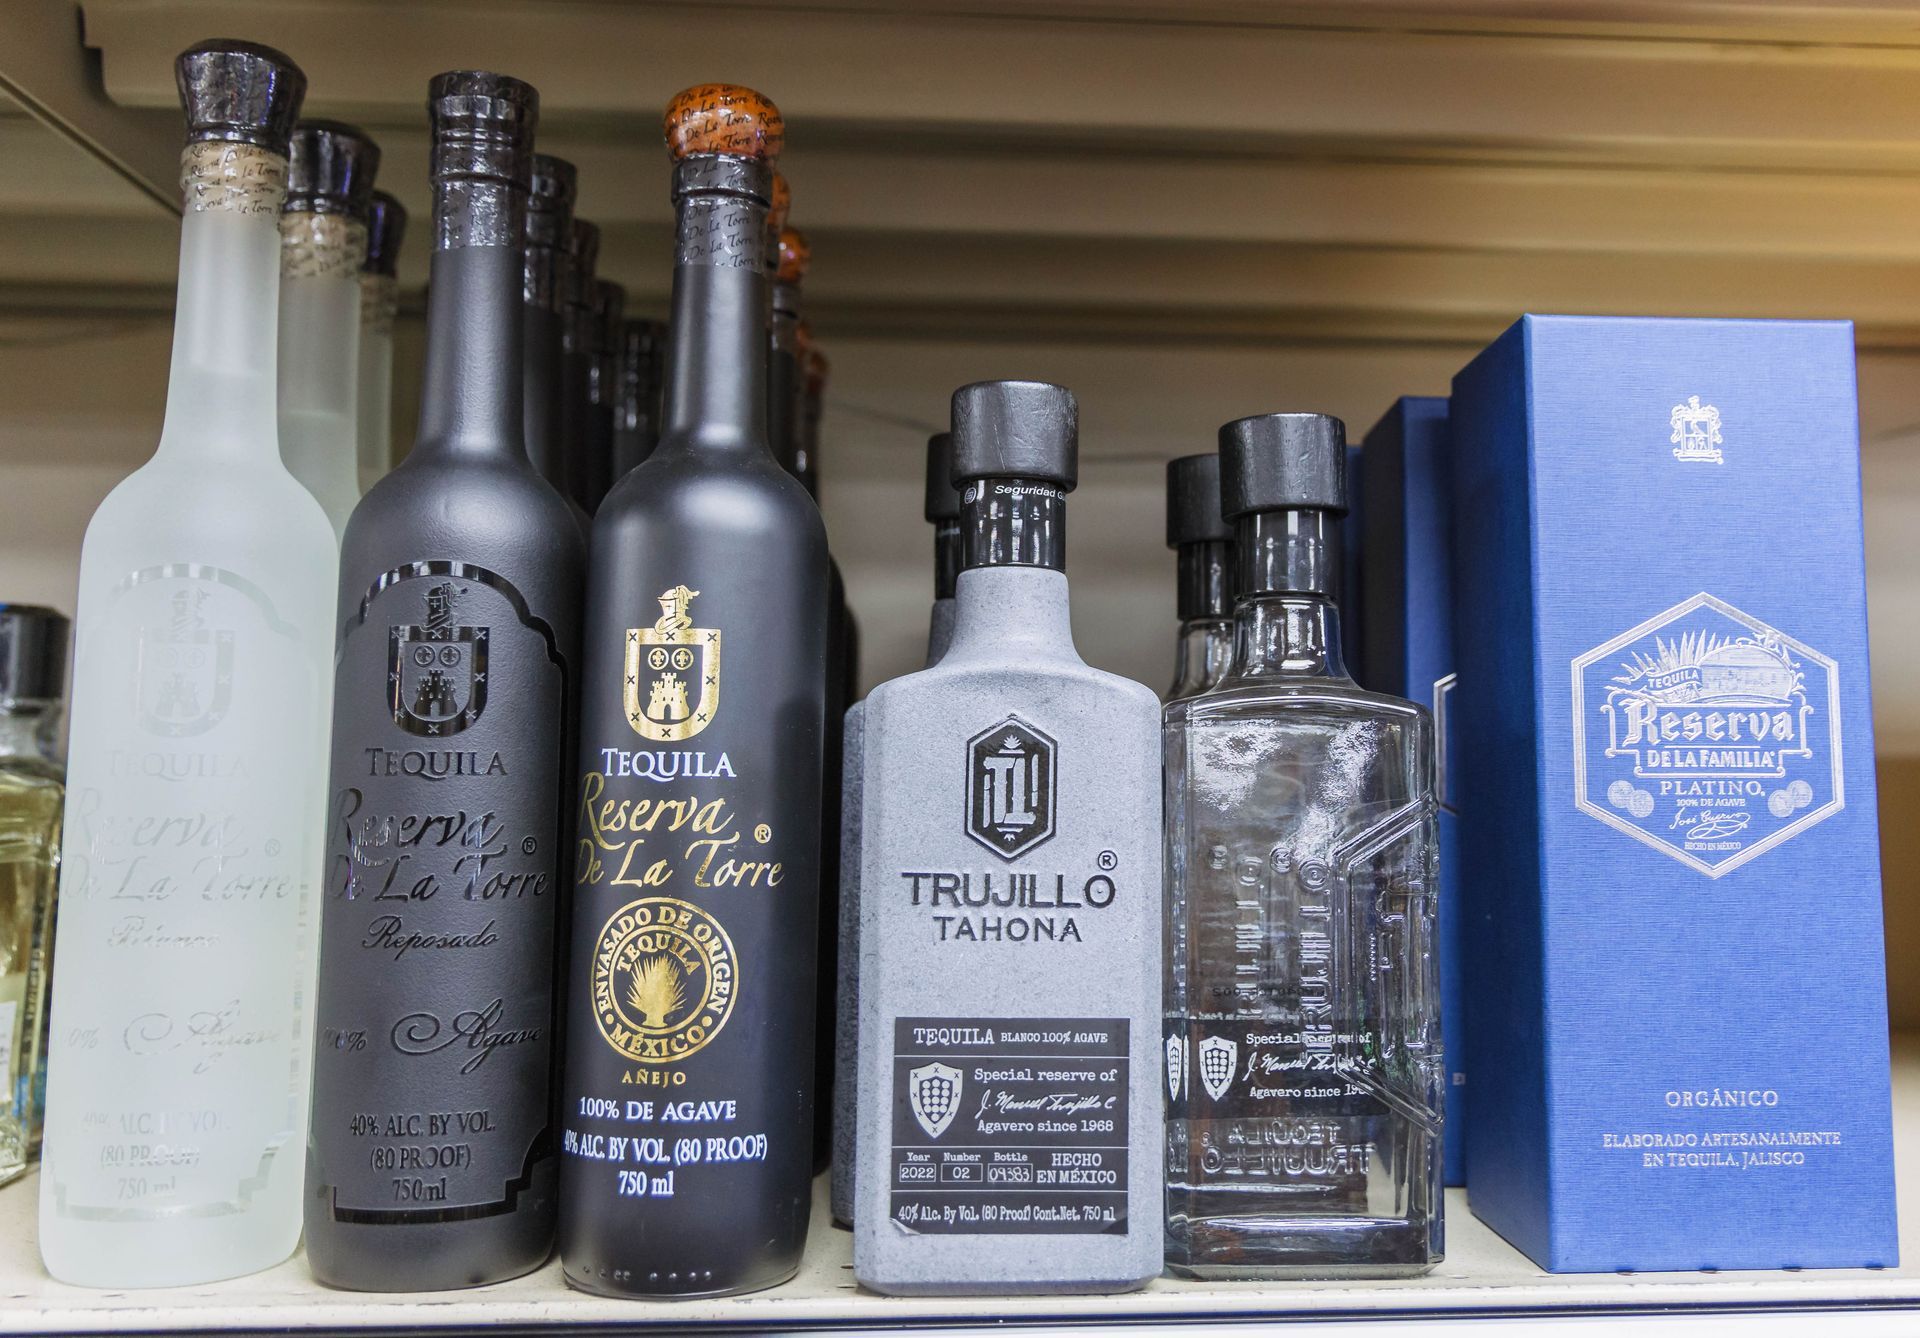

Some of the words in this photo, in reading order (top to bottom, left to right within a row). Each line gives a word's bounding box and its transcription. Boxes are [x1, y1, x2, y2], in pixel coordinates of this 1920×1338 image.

[994, 485, 1056, 498] Seguridad
[1648, 669, 1699, 689] TEQUILA
[1619, 698, 1795, 747] Reserva
[365, 747, 509, 782] TEQUILA
[601, 747, 737, 783] TEQUILA
[1647, 750, 1671, 767] DE
[1675, 750, 1695, 767] LA
[579, 771, 736, 851] Reserva
[1676, 798, 1698, 807] 100%
[1700, 798, 1713, 807] DE
[1715, 798, 1746, 807] AGAVE
[332, 787, 508, 867] Reserva
[577, 838, 605, 886] De
[610, 838, 673, 888] La
[684, 830, 785, 888] Torre
[375, 853, 440, 903] La
[453, 843, 549, 902] Torre
[901, 871, 1117, 909] TRUJILLO
[362, 914, 500, 961] Reposado
[933, 916, 1083, 943] TAHONA
[595, 907, 653, 1015] ENVASADO
[657, 906, 693, 930] DE
[693, 923, 731, 1015] ORIGEN
[617, 933, 701, 976] TEQUILA
[610, 1023, 706, 1058] MÉXICO
[913, 1027, 995, 1046] TEQUILA
[1000, 1032, 1041, 1044] BLANCO
[1042, 1031, 1071, 1045] 100%
[1073, 1032, 1109, 1044] AGAVE
[1246, 1032, 1301, 1046] Special
[621, 1068, 687, 1088] AÑEJO
[974, 1068, 1034, 1084] Special
[1038, 1070, 1096, 1081] reserve
[1099, 1068, 1118, 1081] of
[1249, 1086, 1301, 1100] Agavero
[1303, 1086, 1341, 1098] since
[1665, 1088, 1778, 1107] ORGÁNICO
[580, 1096, 620, 1119] 100%
[626, 1101, 654, 1121] DE
[661, 1100, 738, 1122] AGAVE
[350, 1113, 379, 1137] 40%
[384, 1114, 424, 1137] ALC.
[429, 1113, 452, 1136] BY
[457, 1110, 496, 1135] VOL.
[977, 1119, 1035, 1134] Agavero
[1037, 1119, 1077, 1132] since
[1080, 1119, 1114, 1132] 1968
[580, 1133, 606, 1159] ALC.
[609, 1137, 629, 1161] BY
[632, 1137, 671, 1163] VOL.
[675, 1137, 702, 1166] (80
[705, 1133, 768, 1162] PROOF)
[1603, 1133, 1698, 1149] ELABORADO
[1701, 1131, 1841, 1147] ARTESANALMENTE
[370, 1146, 396, 1174] (80
[400, 1143, 472, 1171] PROOF)
[906, 1152, 931, 1162] Year
[943, 1152, 981, 1162] Number
[994, 1152, 1028, 1162] Bottle
[1051, 1153, 1102, 1167] HECHO
[1643, 1153, 1664, 1167] EN
[1668, 1152, 1740, 1167] TEQUILA,
[1743, 1152, 1805, 1169] JALISCO
[618, 1170, 647, 1196] 750
[651, 1170, 675, 1196] ml
[900, 1167, 935, 1179] 2022
[952, 1166, 970, 1179] 02
[1036, 1170, 1057, 1184] EN
[1058, 1168, 1117, 1185] MÉXICO
[898, 1203, 919, 1221] 40%
[920, 1206, 941, 1222] Alc.
[944, 1206, 957, 1225] By
[958, 1206, 980, 1222] Vol.
[982, 1205, 998, 1221] (80
[1000, 1205, 1032, 1222] Proof)
[1083, 1206, 1101, 1221] 750
[1103, 1206, 1116, 1222] ml
